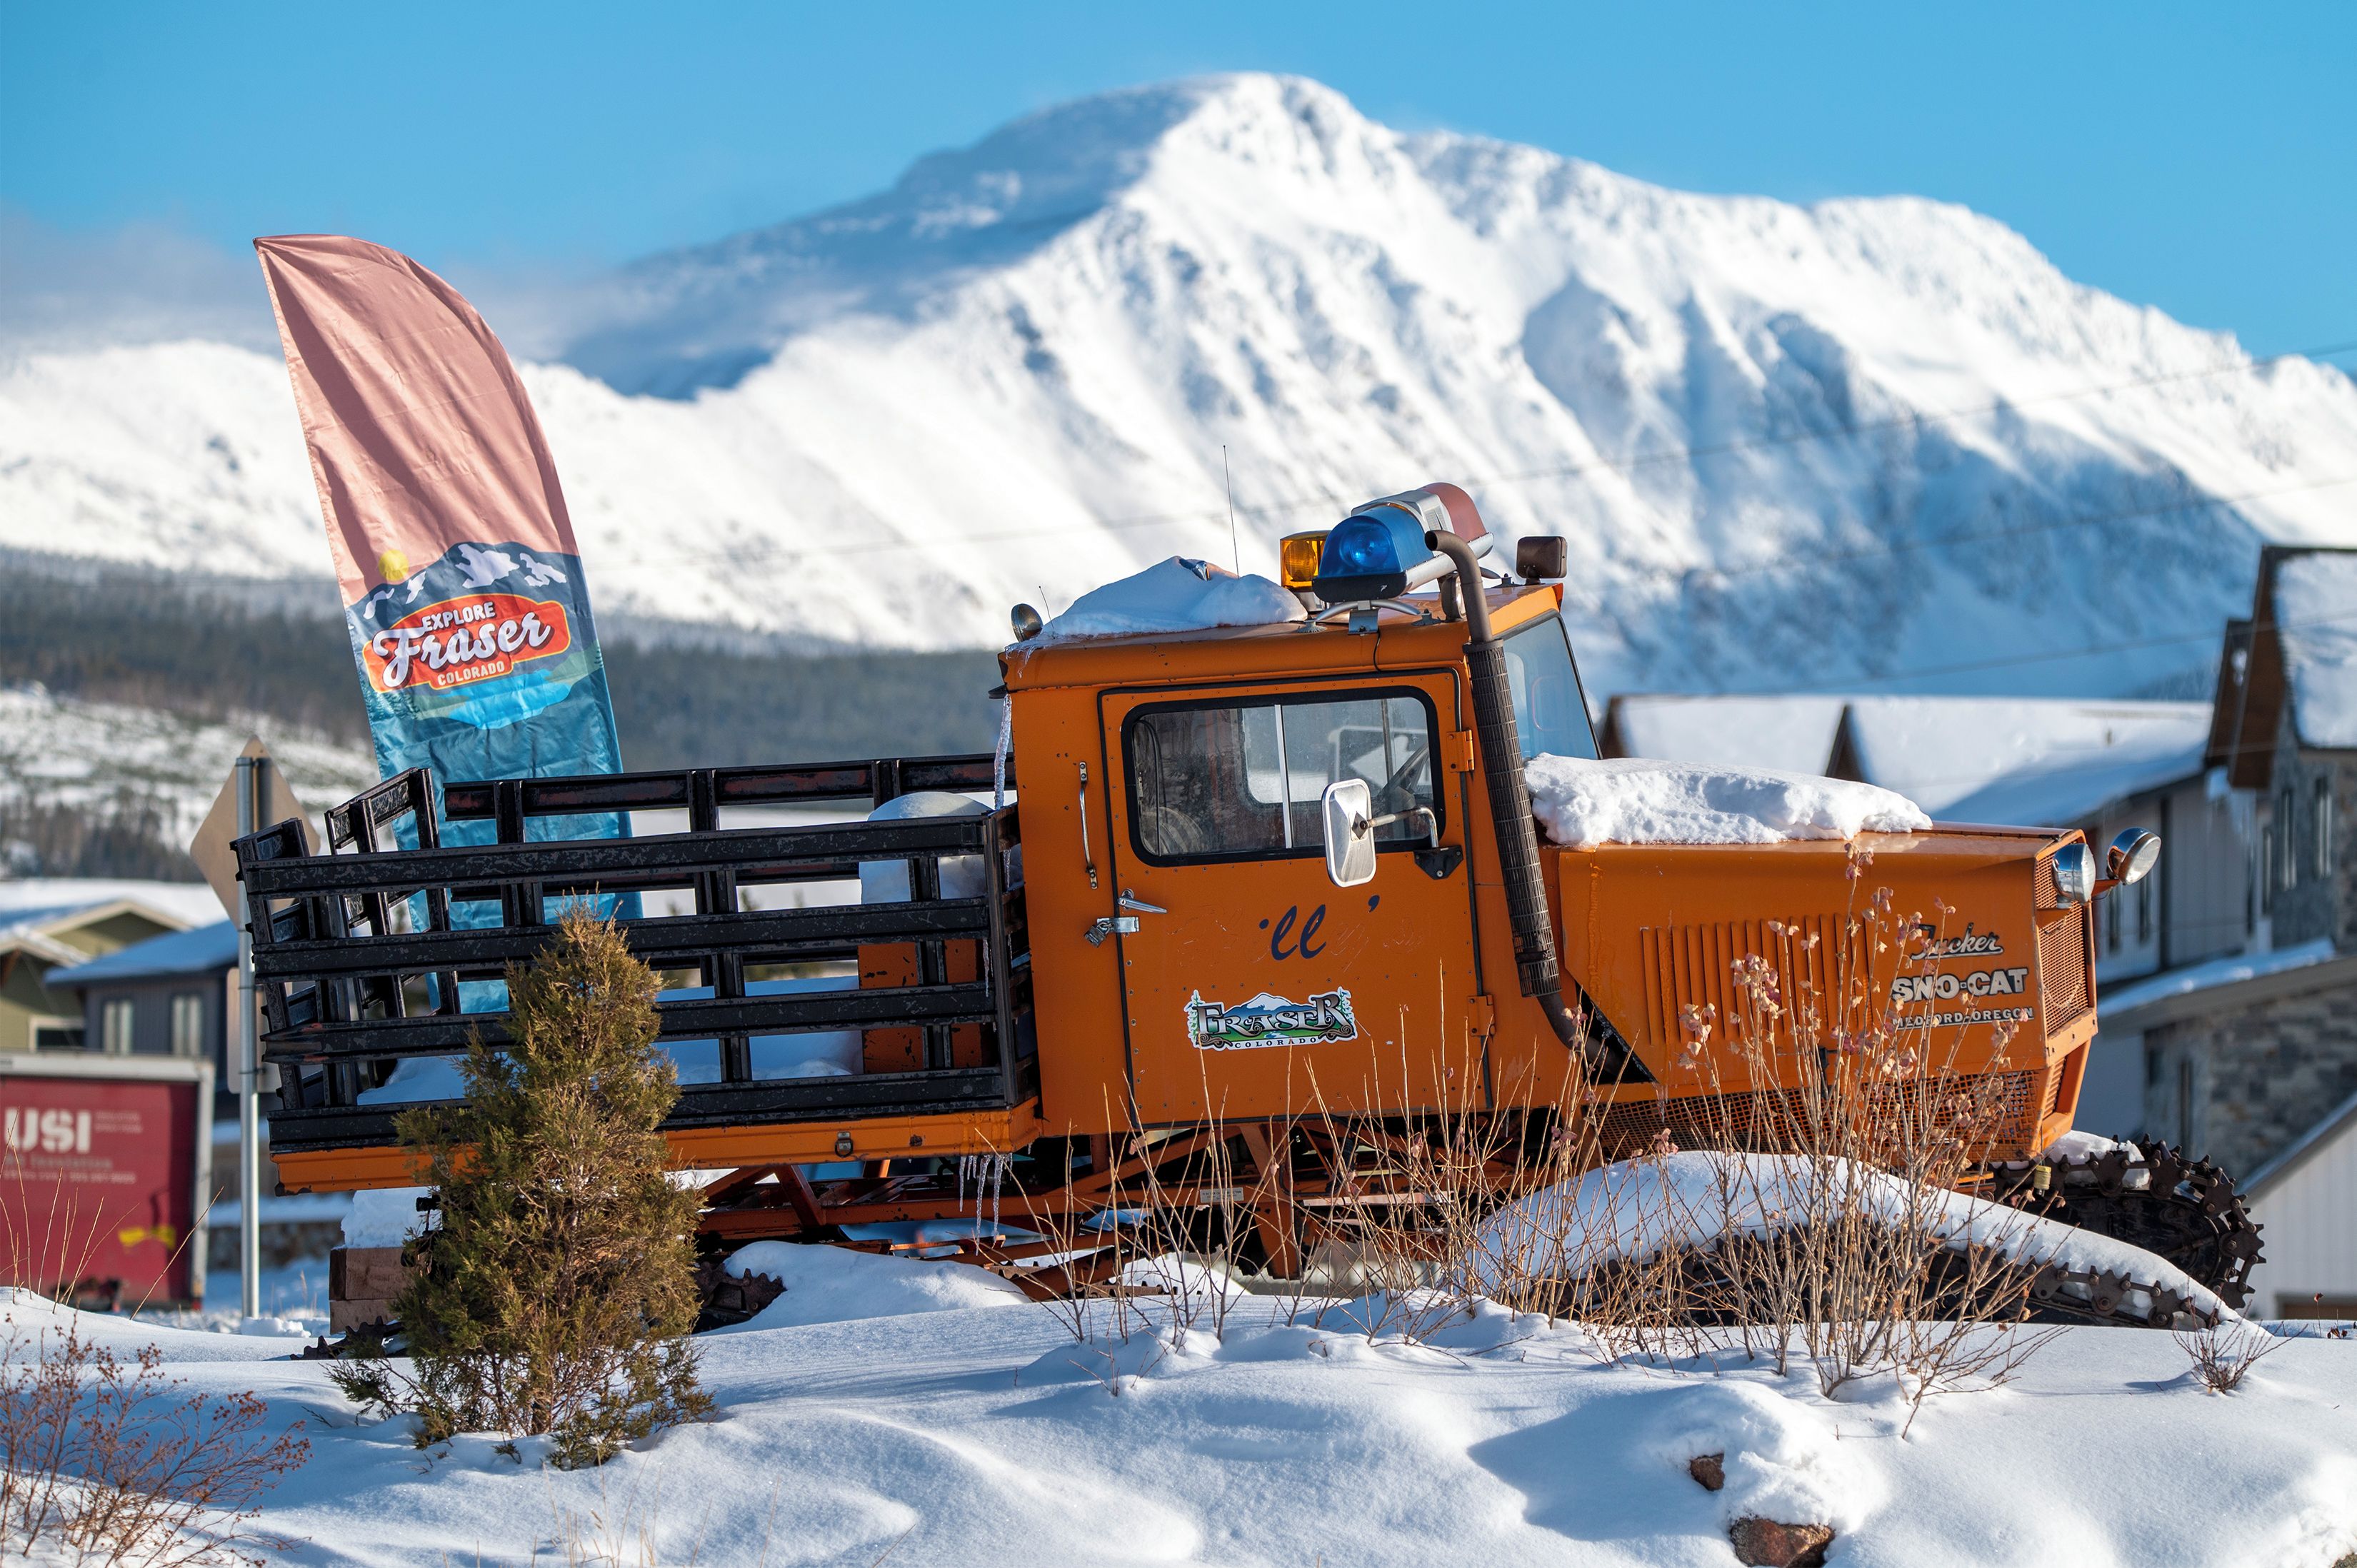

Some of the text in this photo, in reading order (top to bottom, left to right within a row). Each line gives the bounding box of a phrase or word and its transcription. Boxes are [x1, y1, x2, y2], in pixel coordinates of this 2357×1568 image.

[421, 601, 496, 631] EXPLORE
[372, 611, 552, 688] Fraser
[437, 660, 506, 687] COLORADO
[1892, 968, 2029, 1002] SNO-CAT
[1192, 994, 1354, 1037] FRASER
[1234, 1037, 1316, 1048] COLORADO
[4, 1107, 92, 1155] USI
